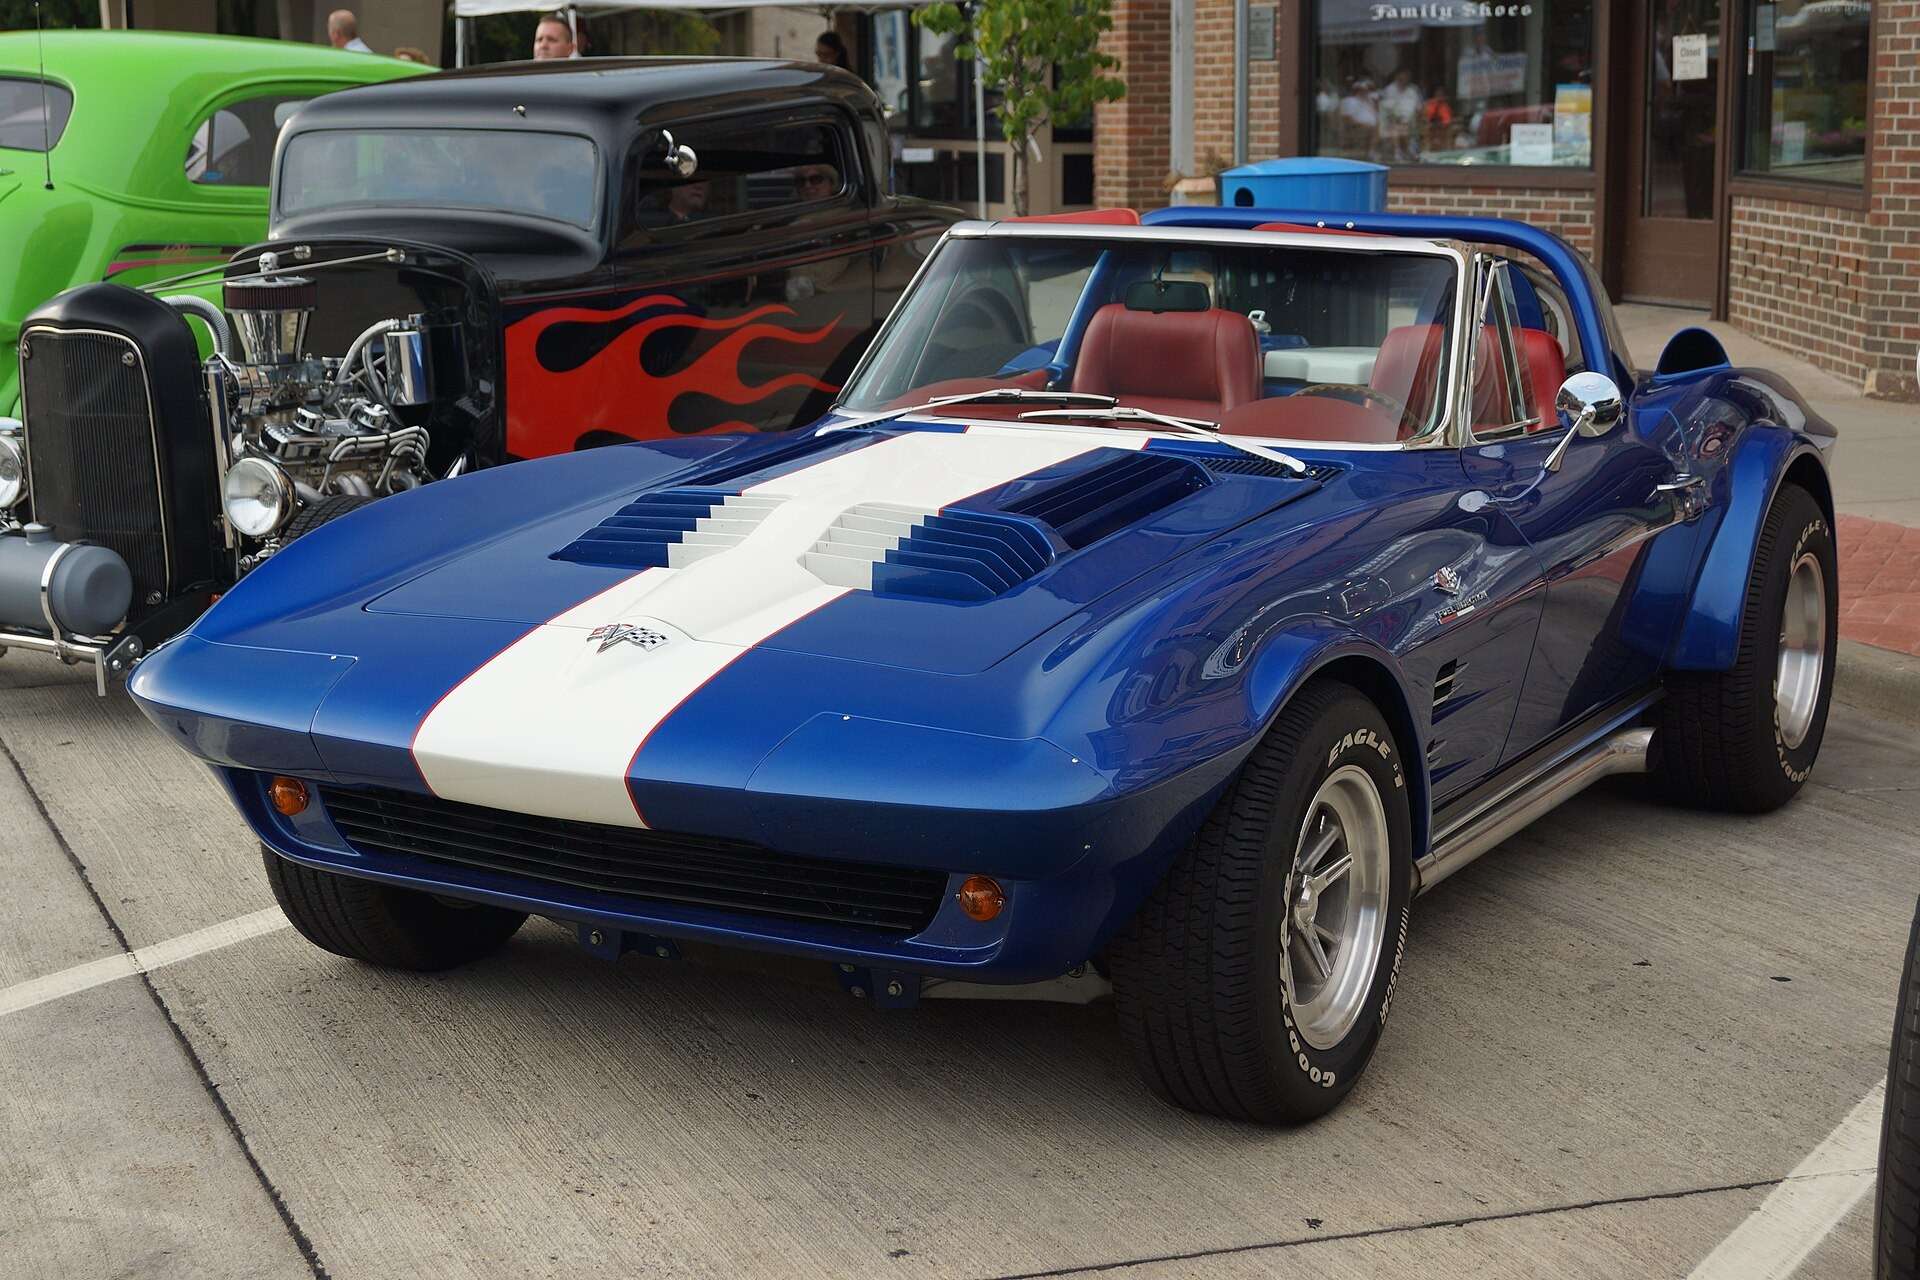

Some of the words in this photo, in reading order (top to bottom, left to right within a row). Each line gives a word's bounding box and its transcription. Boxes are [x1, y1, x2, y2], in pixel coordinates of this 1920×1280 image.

[1369, 3, 1453, 21] Family
[1462, 2, 1532, 18] Shoes
[1328, 728, 1391, 768] EAGLE
[1380, 947, 1402, 1025] NASCAR
